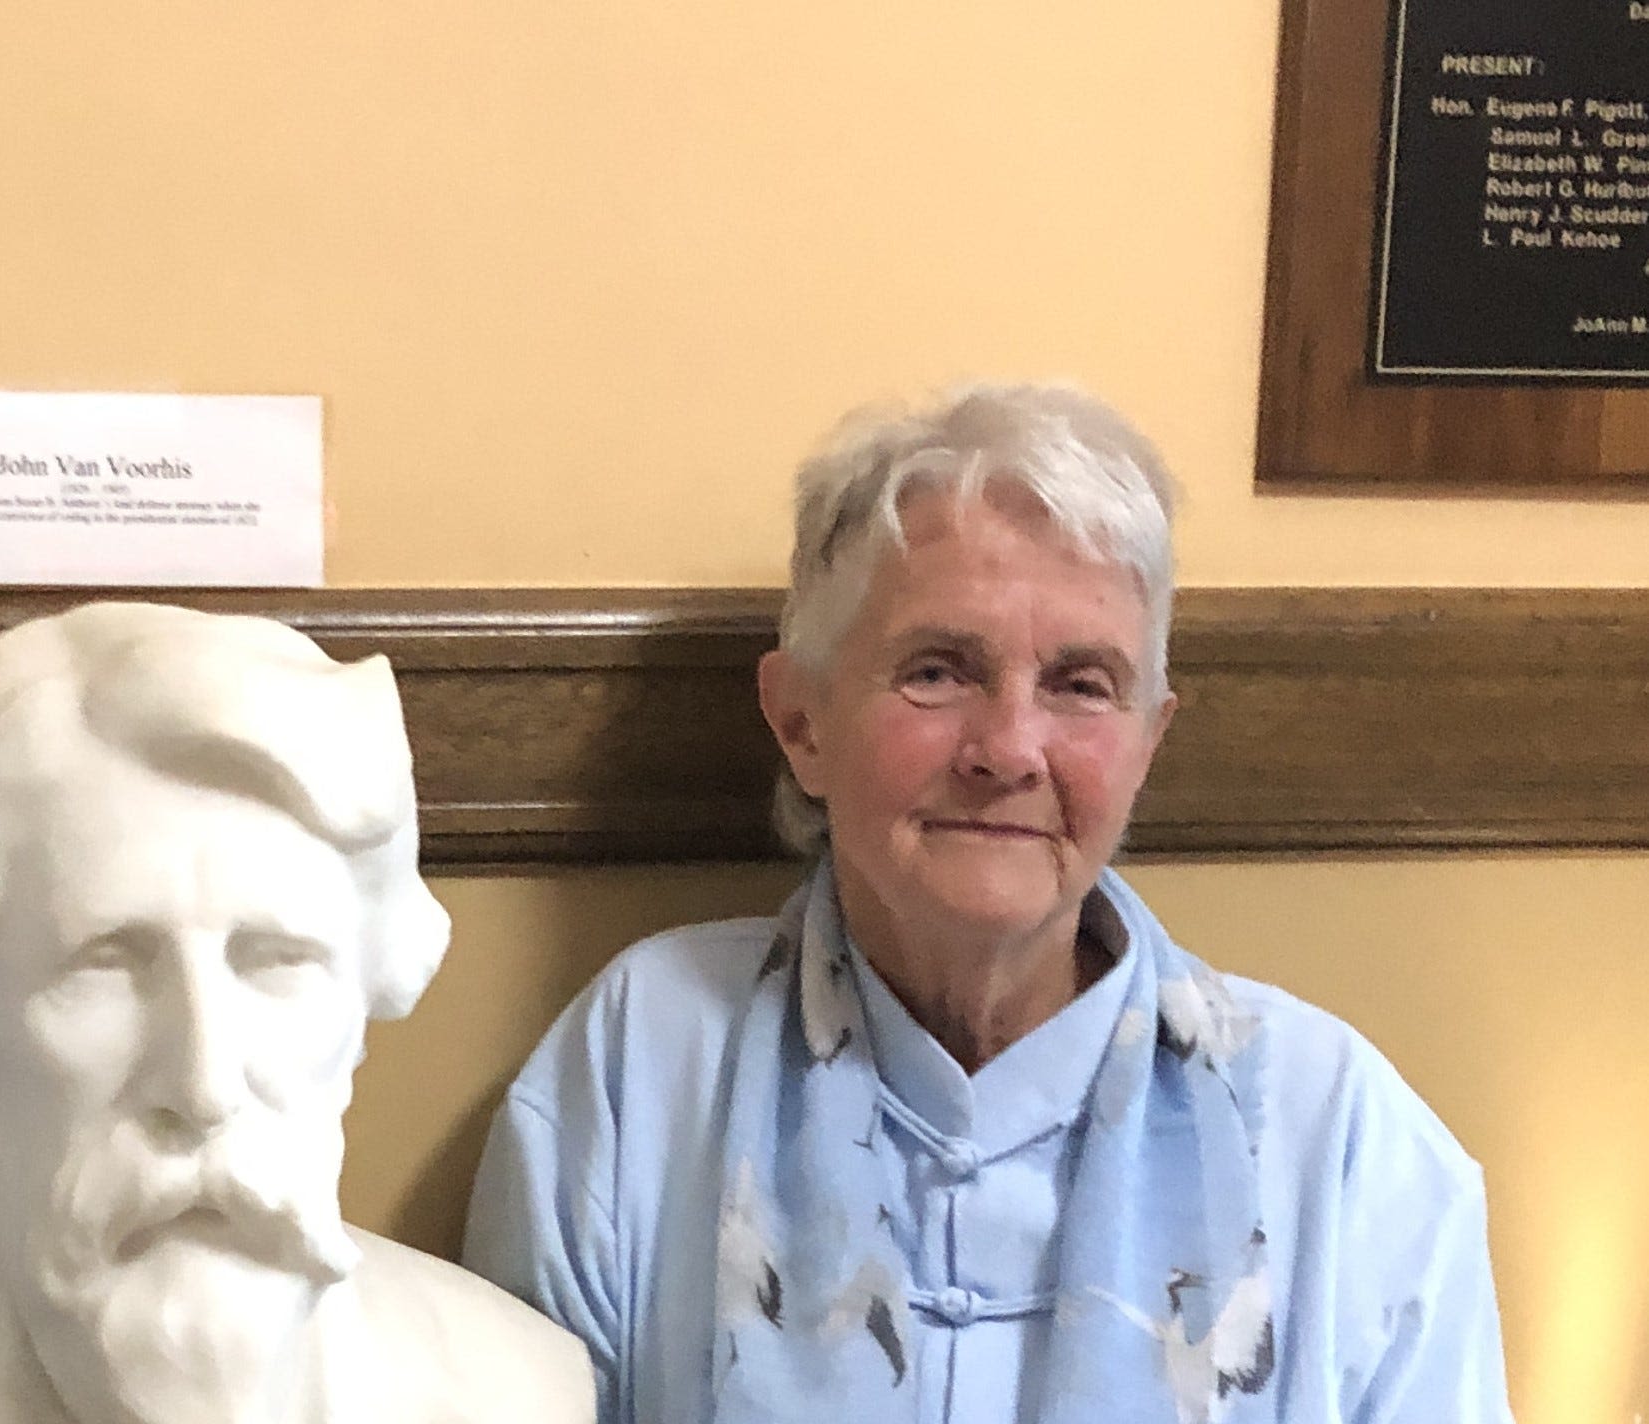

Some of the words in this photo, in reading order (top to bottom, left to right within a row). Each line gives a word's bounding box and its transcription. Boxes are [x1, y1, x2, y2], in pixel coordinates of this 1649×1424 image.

[1431, 97, 1474, 117] Hon.
[1486, 97, 1558, 121] Eugene
[1490, 127, 1562, 146] Samuel
[1602, 128, 1649, 148] Gree
[1488, 153, 1577, 173] Elizabeth
[1616, 155, 1649, 174] Pin
[1486, 177, 1552, 198] Robert
[1583, 180, 1649, 199] Hurlbu
[1484, 204, 1541, 226] Henry
[1510, 228, 1552, 248] Paul
[1561, 230, 1622, 249] Kehoe
[54, 454, 100, 477] Van
[105, 454, 193, 479] Voorhis
